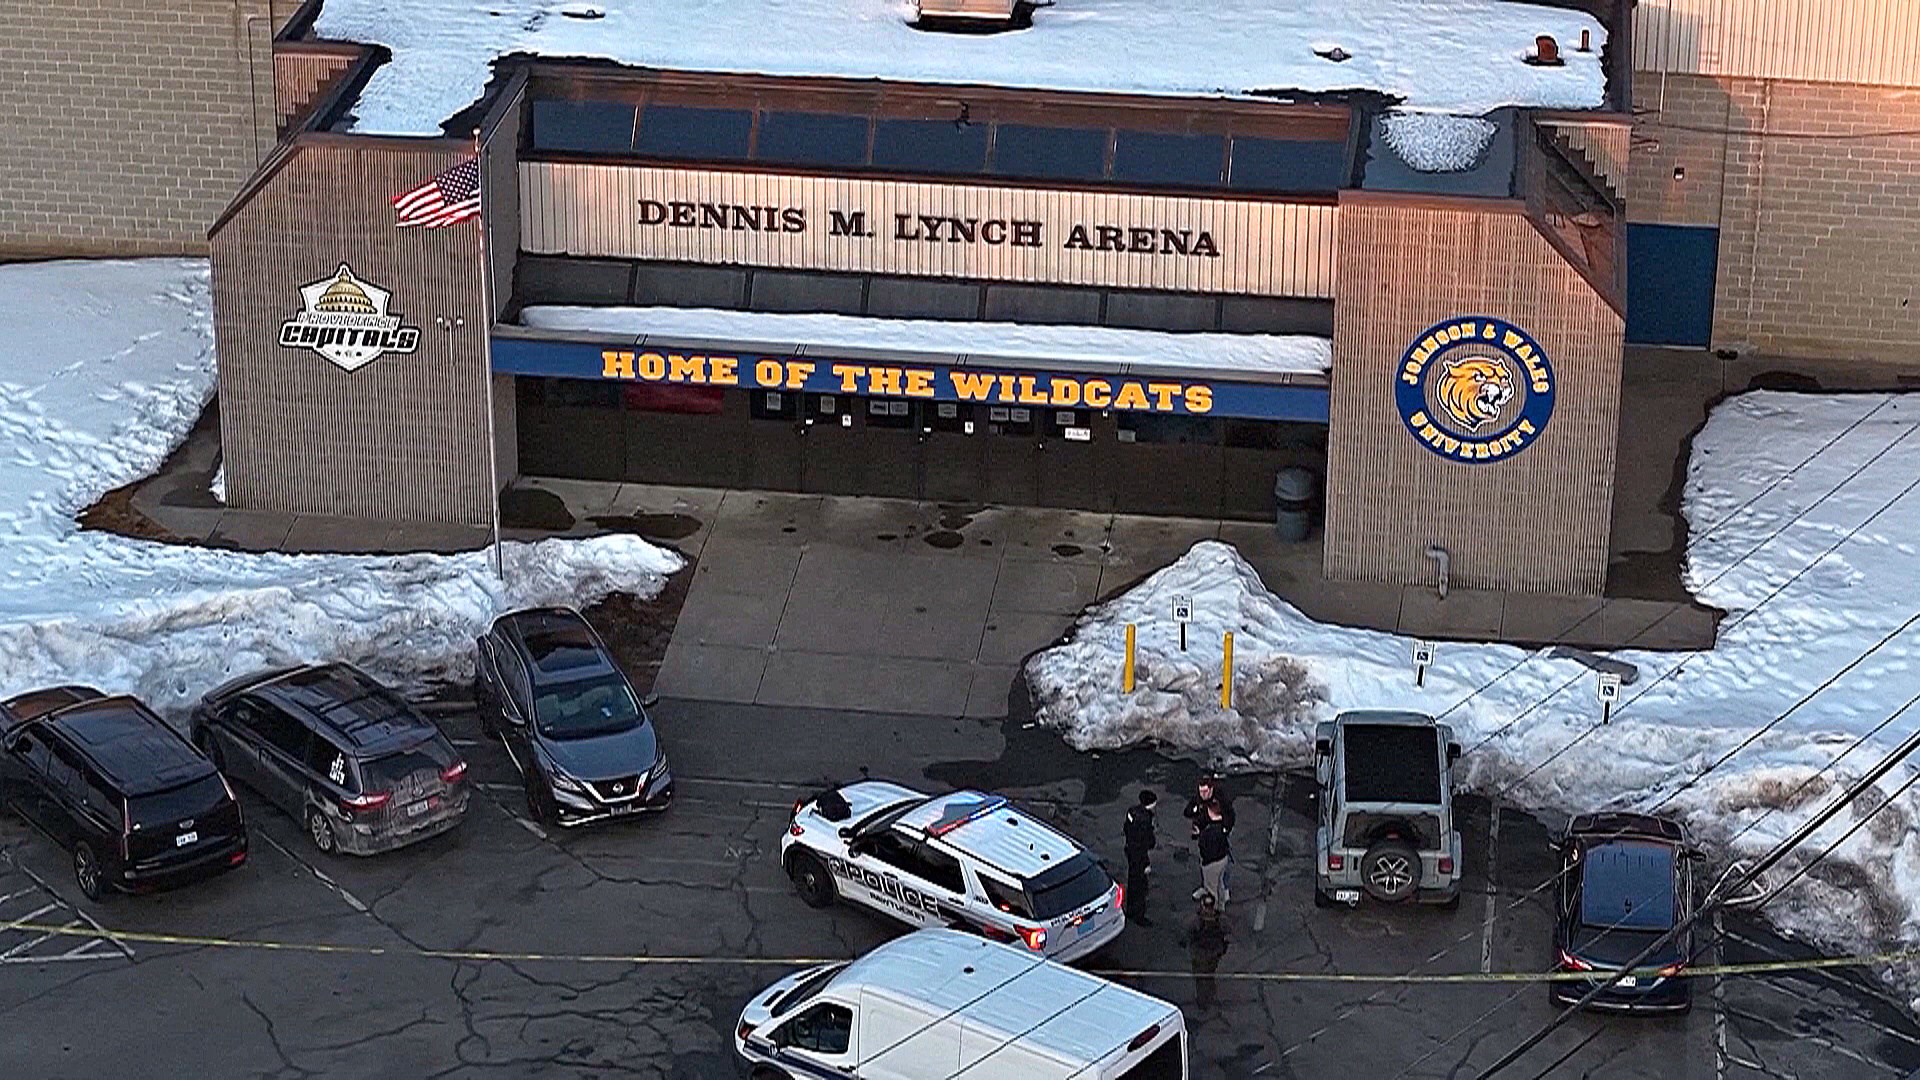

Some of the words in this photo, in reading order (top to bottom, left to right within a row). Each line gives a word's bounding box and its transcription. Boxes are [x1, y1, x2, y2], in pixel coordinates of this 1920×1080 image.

[637, 199, 807, 233] DENNIS
[828, 209, 876, 238] M.
[894, 213, 1043, 247] LYNCH
[1063, 224, 1221, 257] ARENA
[601, 351, 739, 385] HOME
[755, 359, 816, 389] OF
[832, 363, 935, 398] THE
[949, 370, 1213, 413] WILDCATS
[1402, 323, 1476, 385] JOHNSON
[1482, 323, 1497, 340] &
[1503, 330, 1549, 393] WALES
[1410, 411, 1535, 458] UNIVERSITY
[847, 862, 942, 919] POLICE
